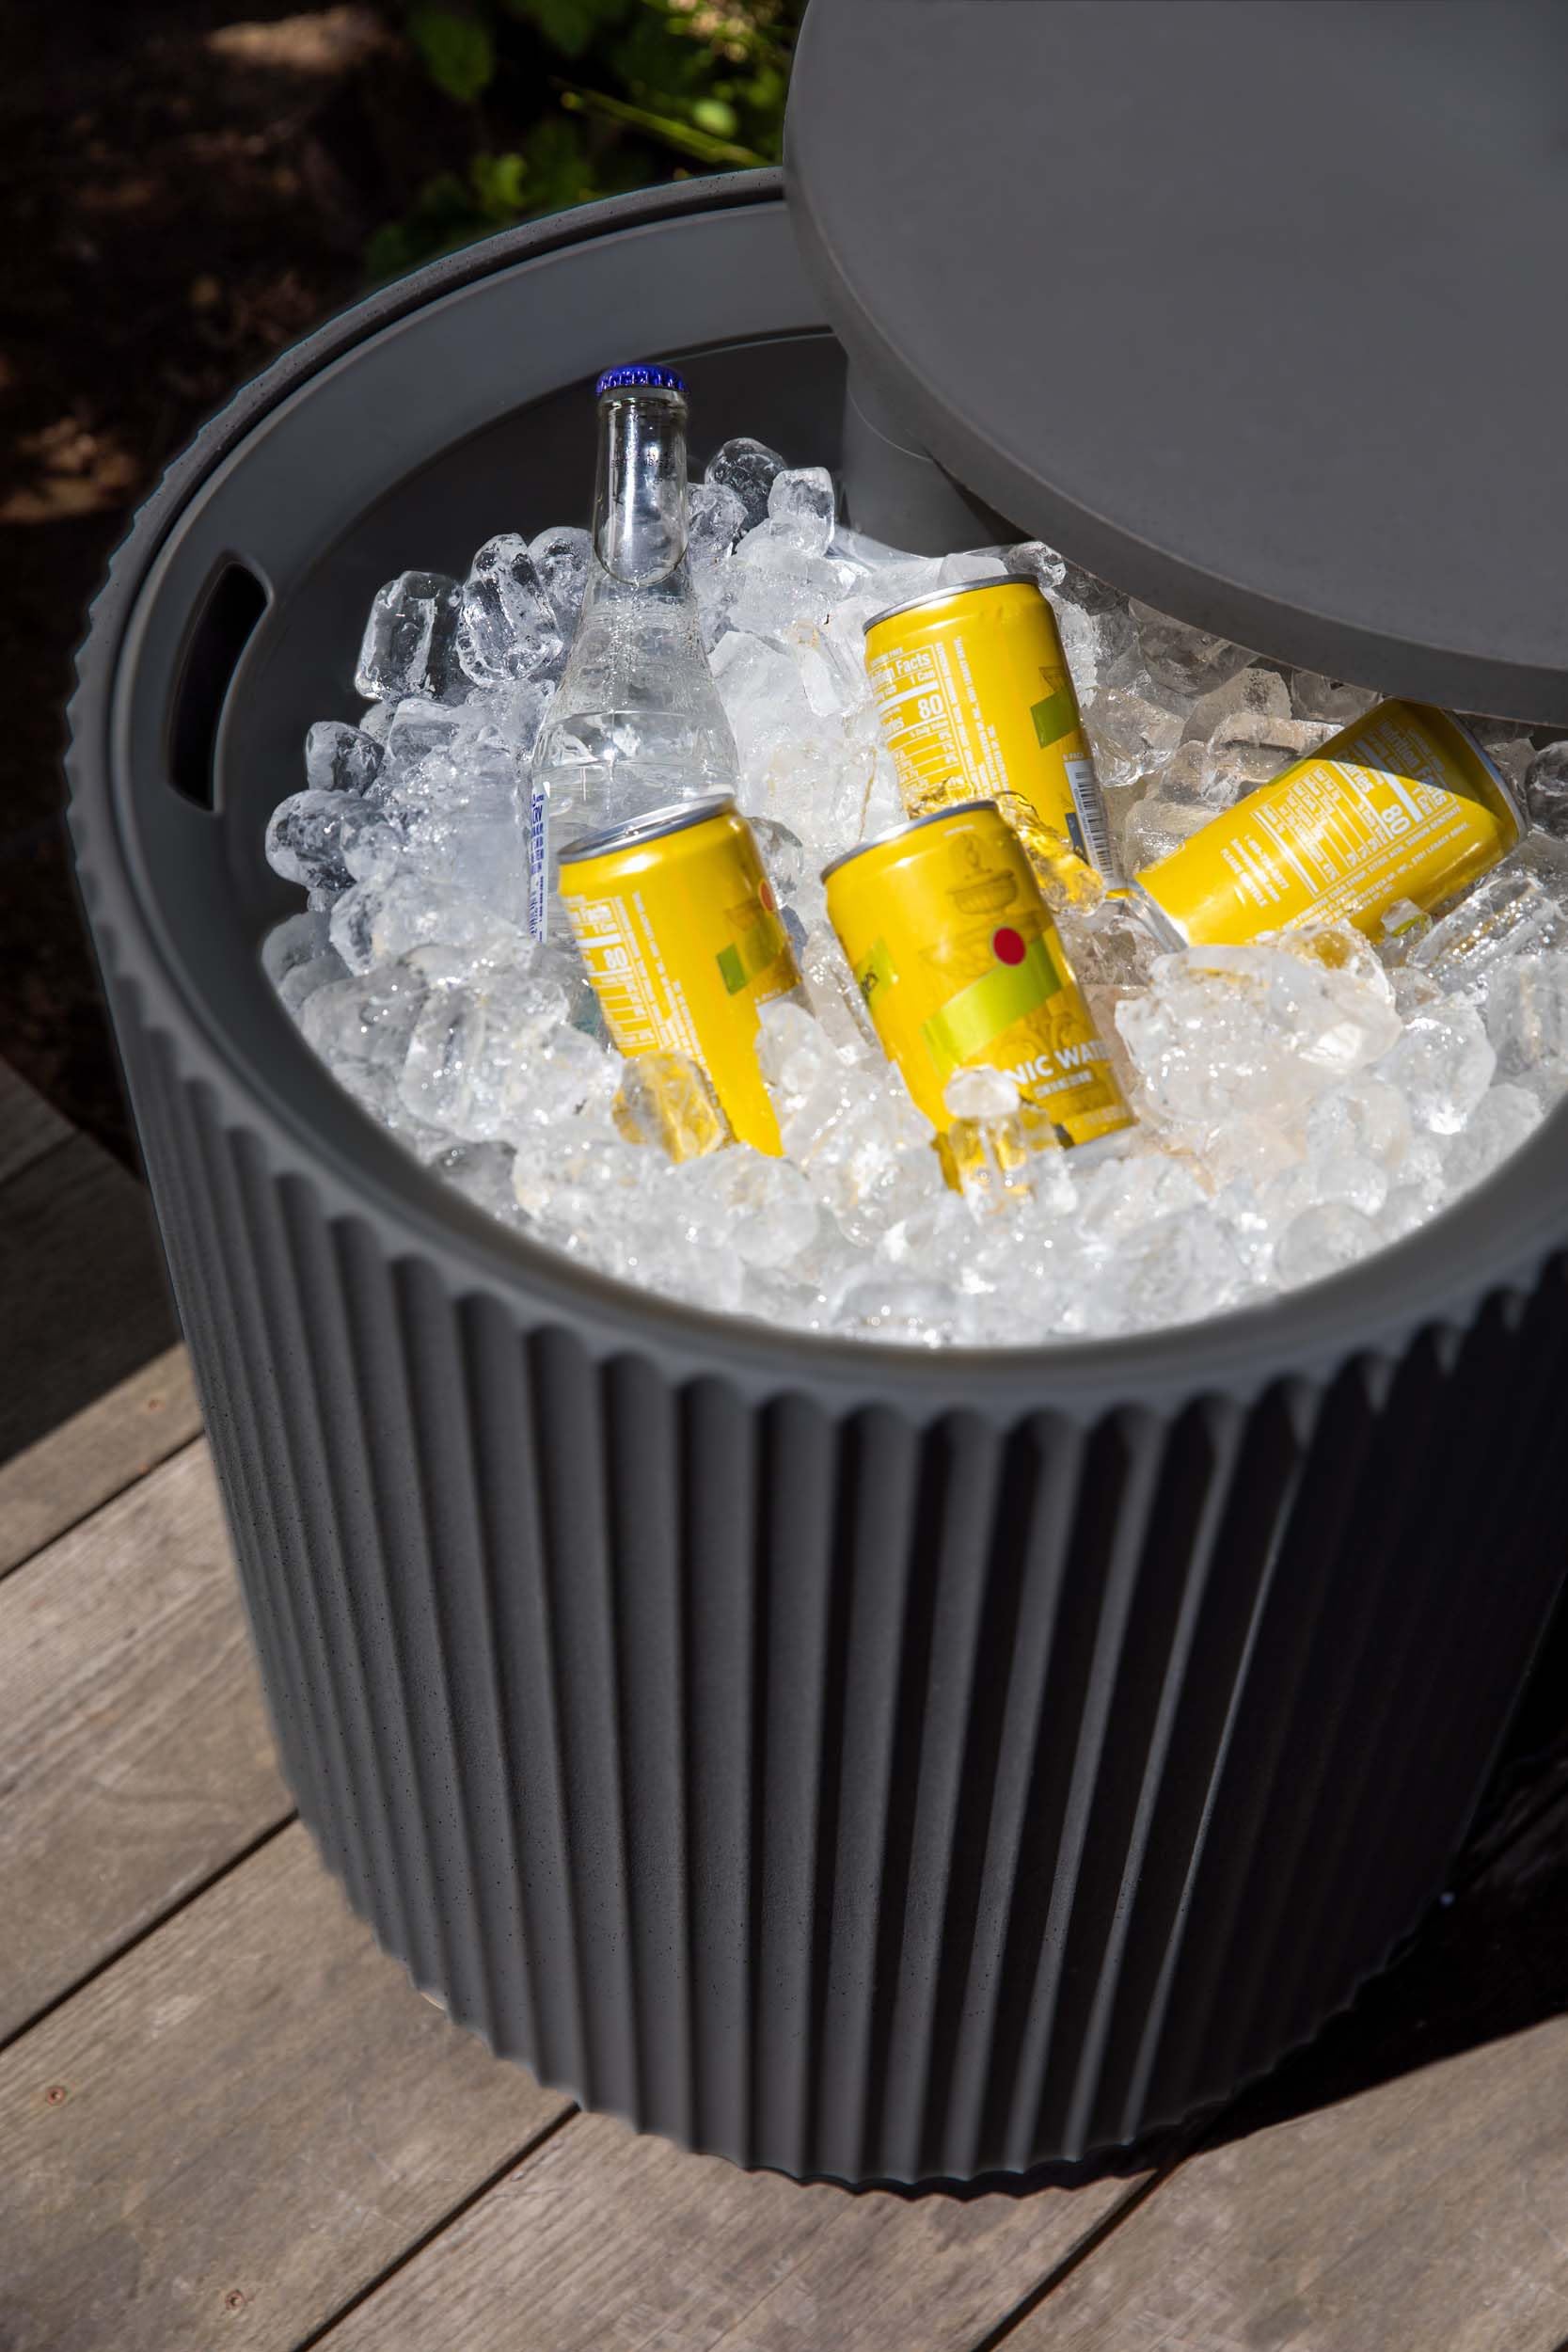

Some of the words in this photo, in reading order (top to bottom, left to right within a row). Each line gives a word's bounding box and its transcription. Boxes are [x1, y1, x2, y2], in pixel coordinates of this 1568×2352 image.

[895, 652, 931, 675] Facts
[917, 693, 943, 720] 80
[1378, 803, 1412, 835] 80
[603, 946, 628, 969] 80
[1003, 1055, 1053, 1085] NIC
